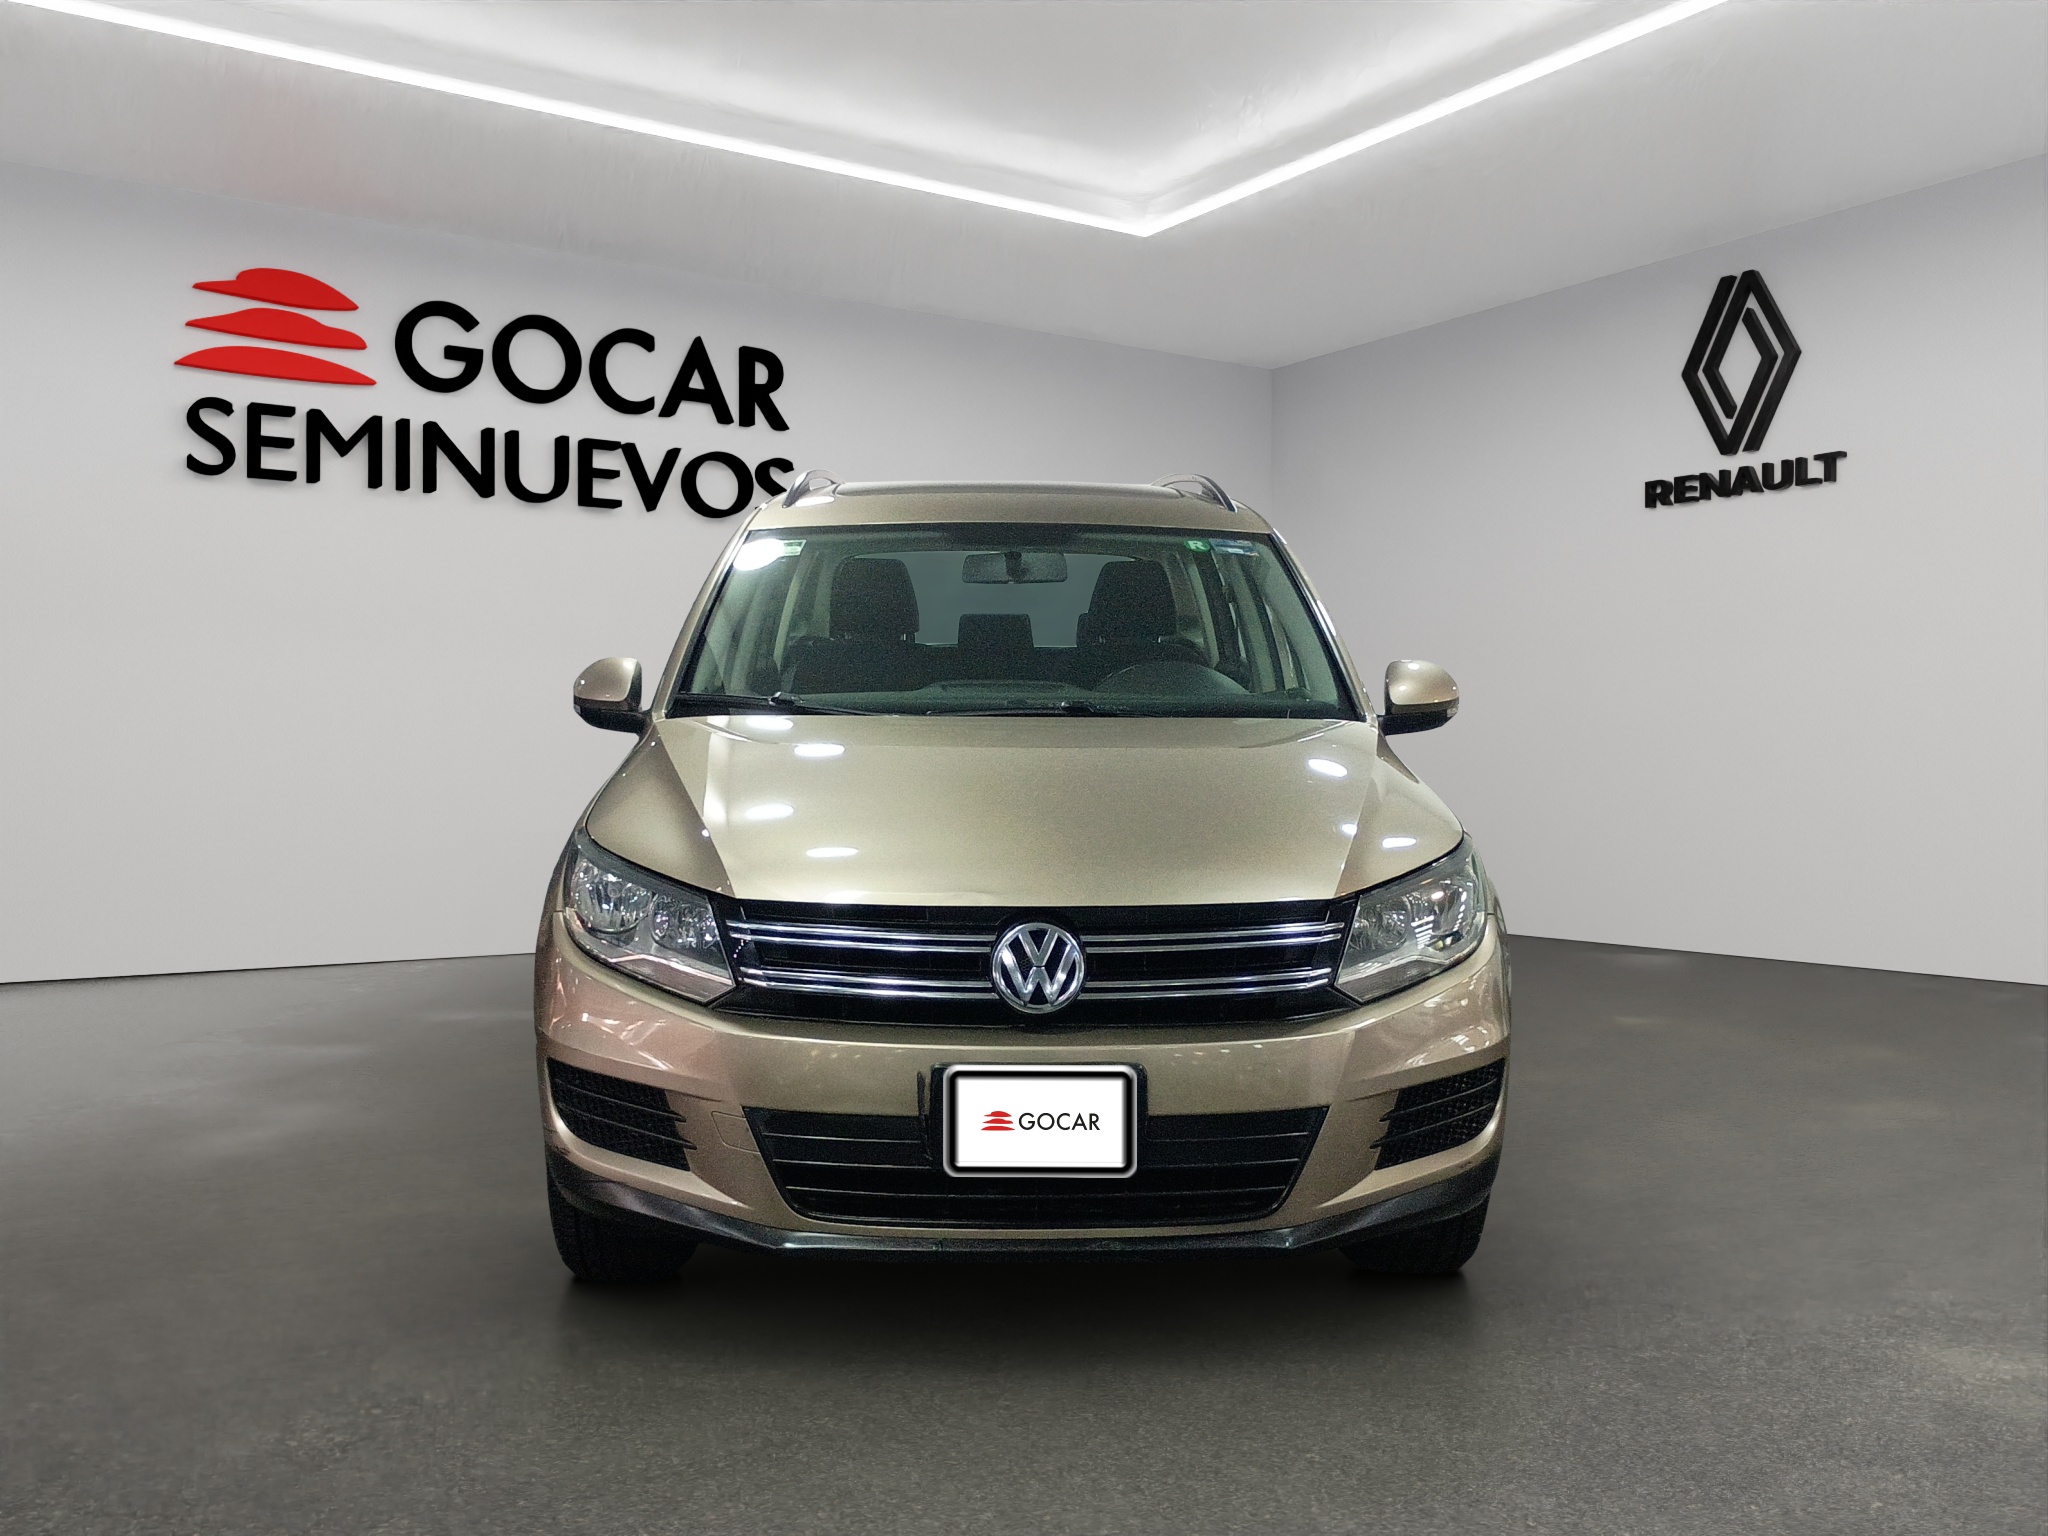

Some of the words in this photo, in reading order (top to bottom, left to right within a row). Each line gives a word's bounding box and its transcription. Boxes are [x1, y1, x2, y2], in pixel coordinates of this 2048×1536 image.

[394, 300, 790, 432] GOCAR
[186, 396, 794, 518] SEMINUEVOS
[1645, 450, 1848, 508] RENAULT
[1018, 1112, 1101, 1131] GOCAR
